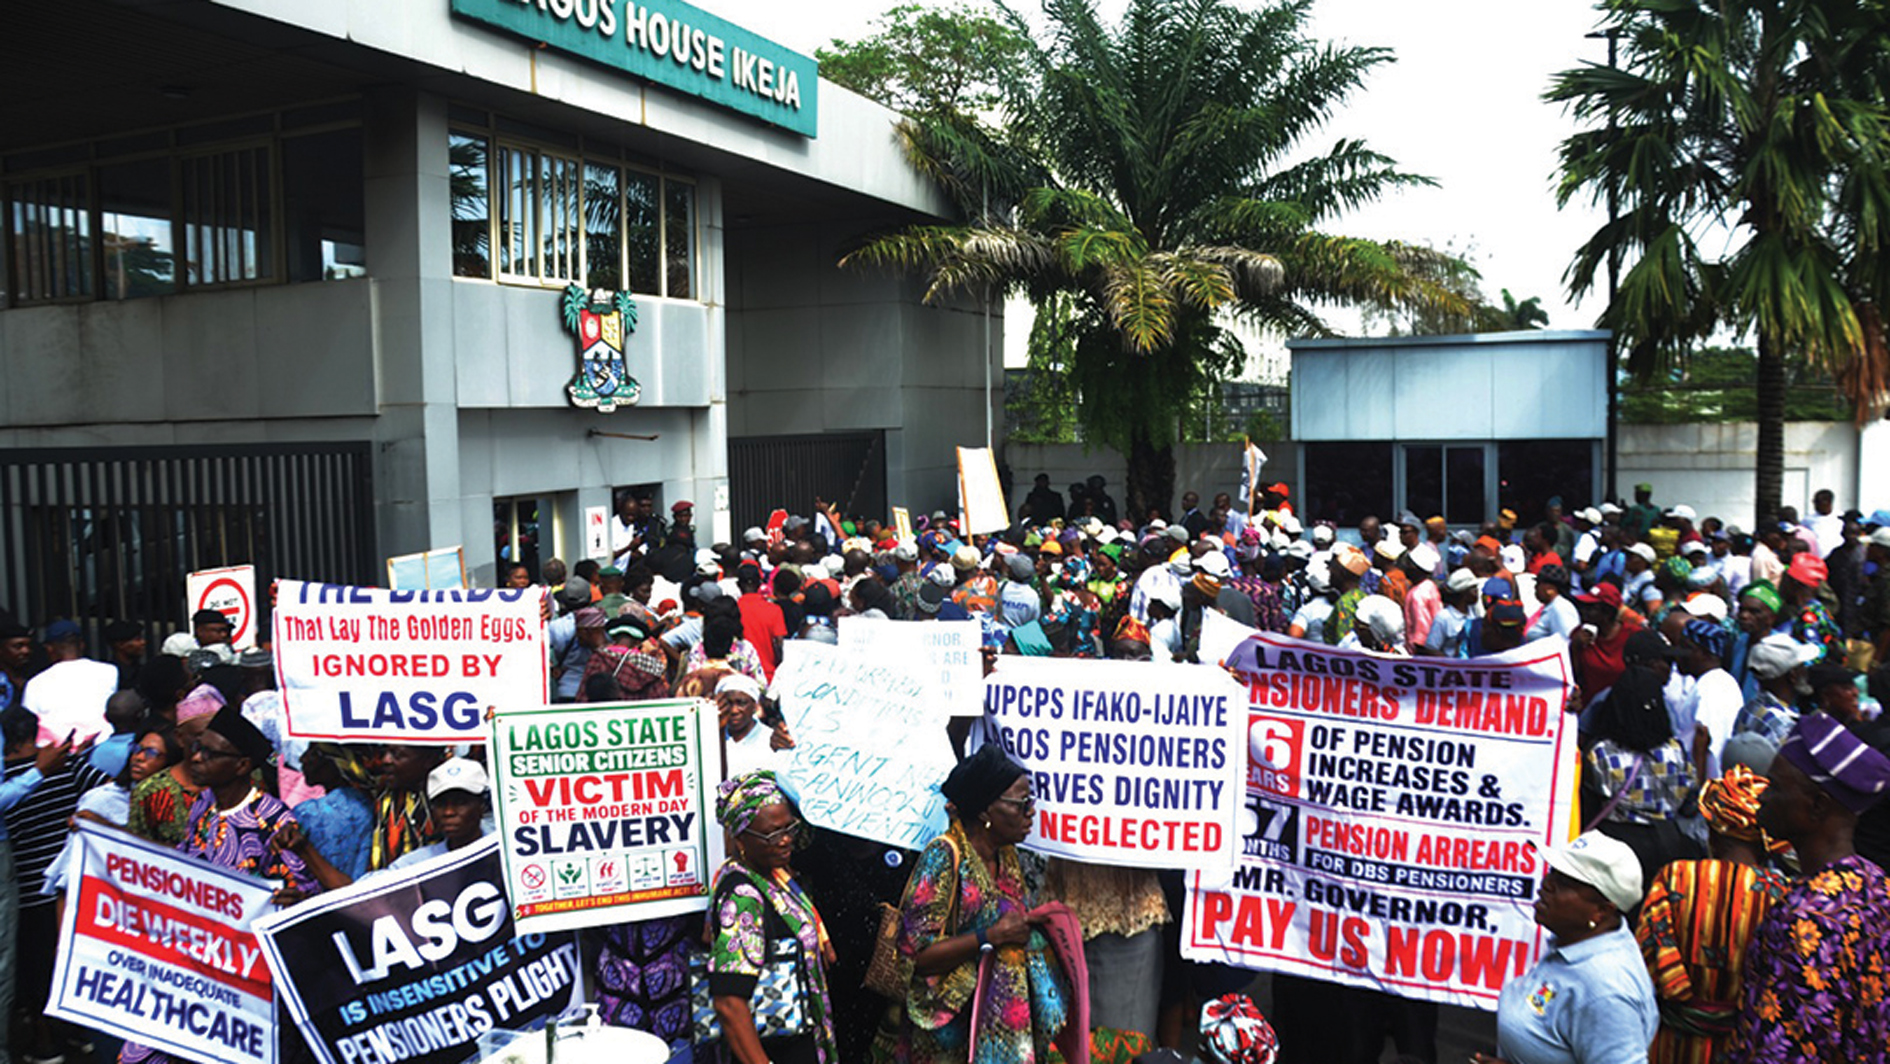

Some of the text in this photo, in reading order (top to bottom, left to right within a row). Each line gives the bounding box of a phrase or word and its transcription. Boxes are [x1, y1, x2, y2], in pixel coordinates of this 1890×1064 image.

[508, 0, 801, 109] GOS HOUSE IKEJA
[284, 614, 533, 643] That Lay The Golden Eggs.
[313, 654, 503, 677] IGNORED BY
[1255, 646, 1511, 689] LAGOS STATE
[339, 691, 481, 731] LASG
[985, 684, 1227, 727] UPCPS IFAKO-IJAIYE
[1414, 691, 1554, 738] DEMAND.
[509, 715, 687, 751] LAGOS STATE
[1060, 730, 1226, 769] PENSIONERS
[1249, 719, 1293, 772] 6
[1310, 725, 1475, 768] OF PENSION
[513, 746, 685, 776] SENIOR CITIZENS
[1247, 766, 1290, 793] ARS
[1308, 753, 1501, 798] INCREASES &
[524, 768, 684, 807] VICTIM
[1028, 771, 1224, 810] RVES DIGNITY
[1306, 779, 1531, 828] WAGE AWARDS.
[519, 798, 689, 824] OF THE MODERN DAY
[1040, 809, 1222, 851] NEGLECTED
[514, 812, 696, 857] SLAVERY
[1245, 837, 1290, 860] NTHS
[1306, 816, 1536, 875] PENSION ARREARS
[107, 852, 243, 920] PENSIONERS
[1311, 852, 1524, 895] FOR DBS PENSIONERS
[1232, 865, 1498, 934] MR. GOVERNOR,
[94, 892, 260, 979] DIE WEEKLY
[331, 881, 506, 985] LASG
[1201, 891, 1529, 990] PAY US NOW!
[107, 950, 242, 1009] OVER INADEQUATE
[338, 933, 547, 1026] IS INSENSITIVE TO
[74, 966, 264, 1059] HEALTHCARE
[335, 942, 576, 1064] PENSIONERS PLIGHT
